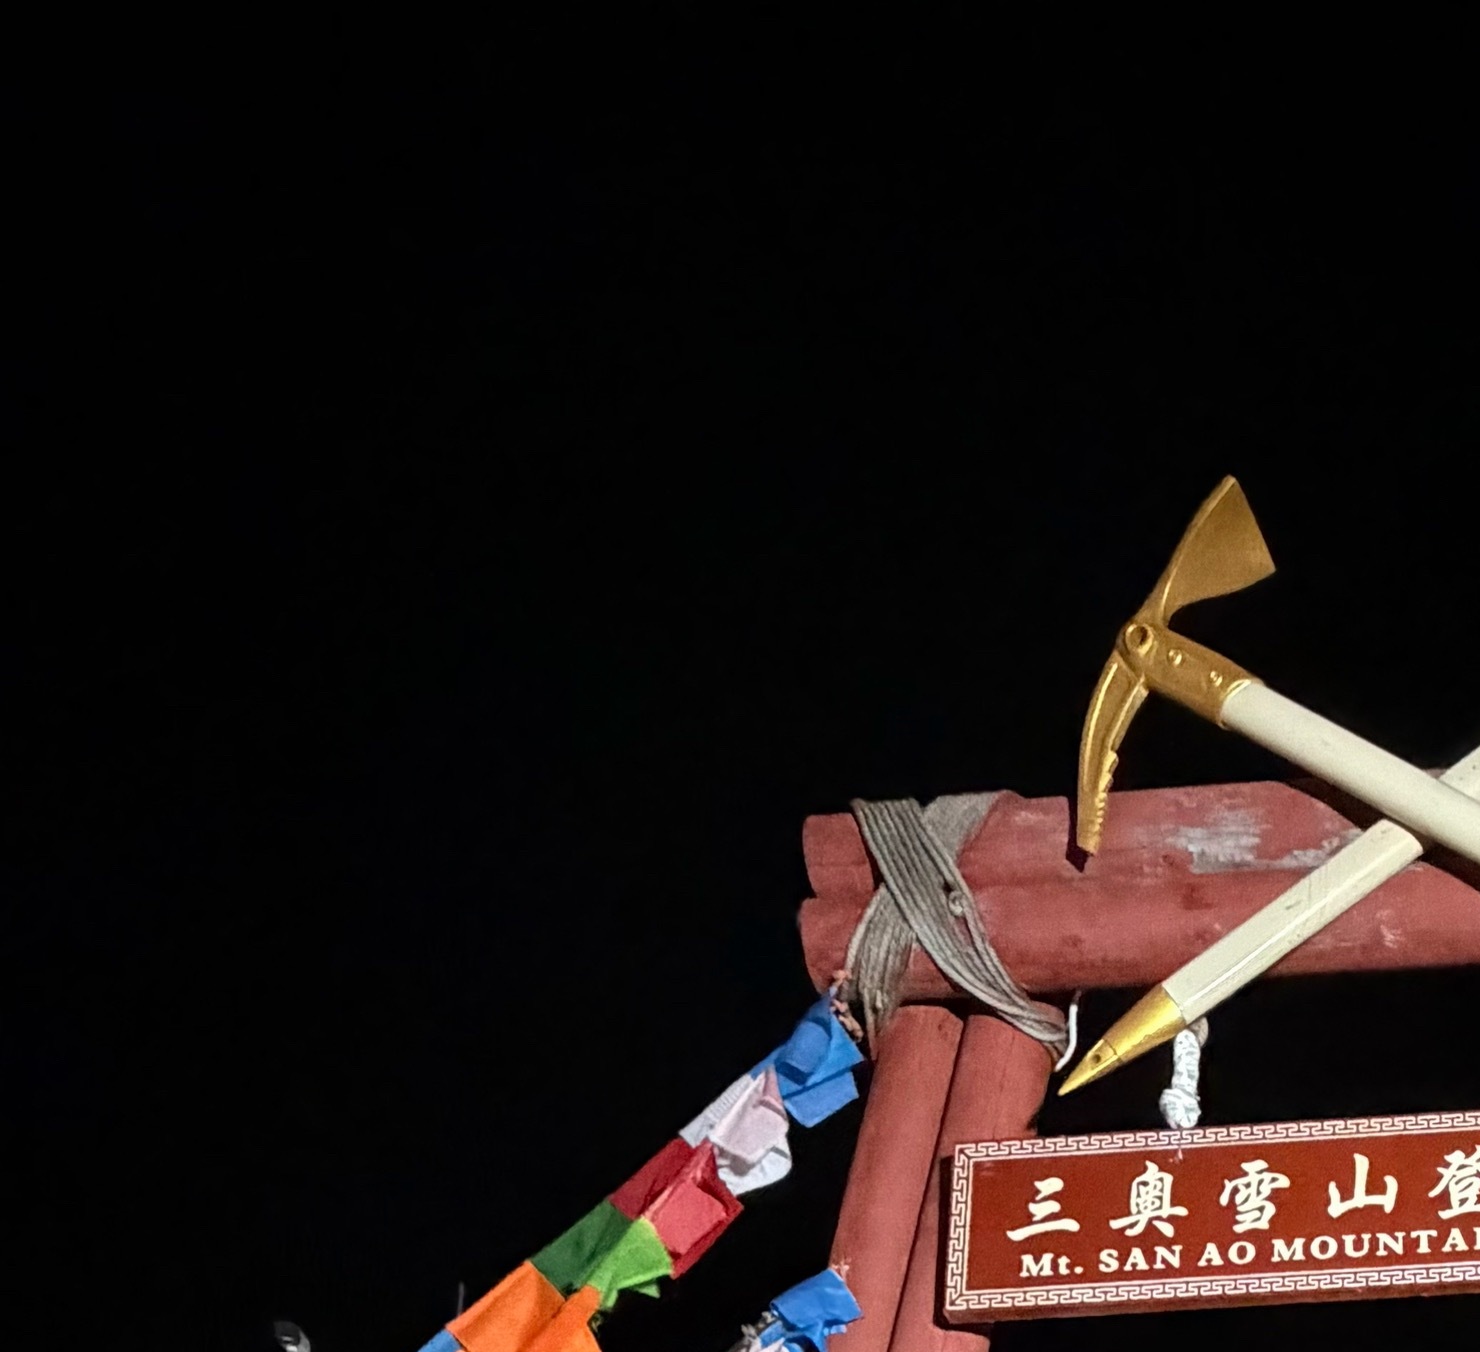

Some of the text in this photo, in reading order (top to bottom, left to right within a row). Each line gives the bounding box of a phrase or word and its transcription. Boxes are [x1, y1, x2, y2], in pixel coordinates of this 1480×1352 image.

[1019, 1252, 1084, 1278] Mt.
[1098, 1244, 1183, 1273] SAN
[1197, 1241, 1256, 1267] AO
